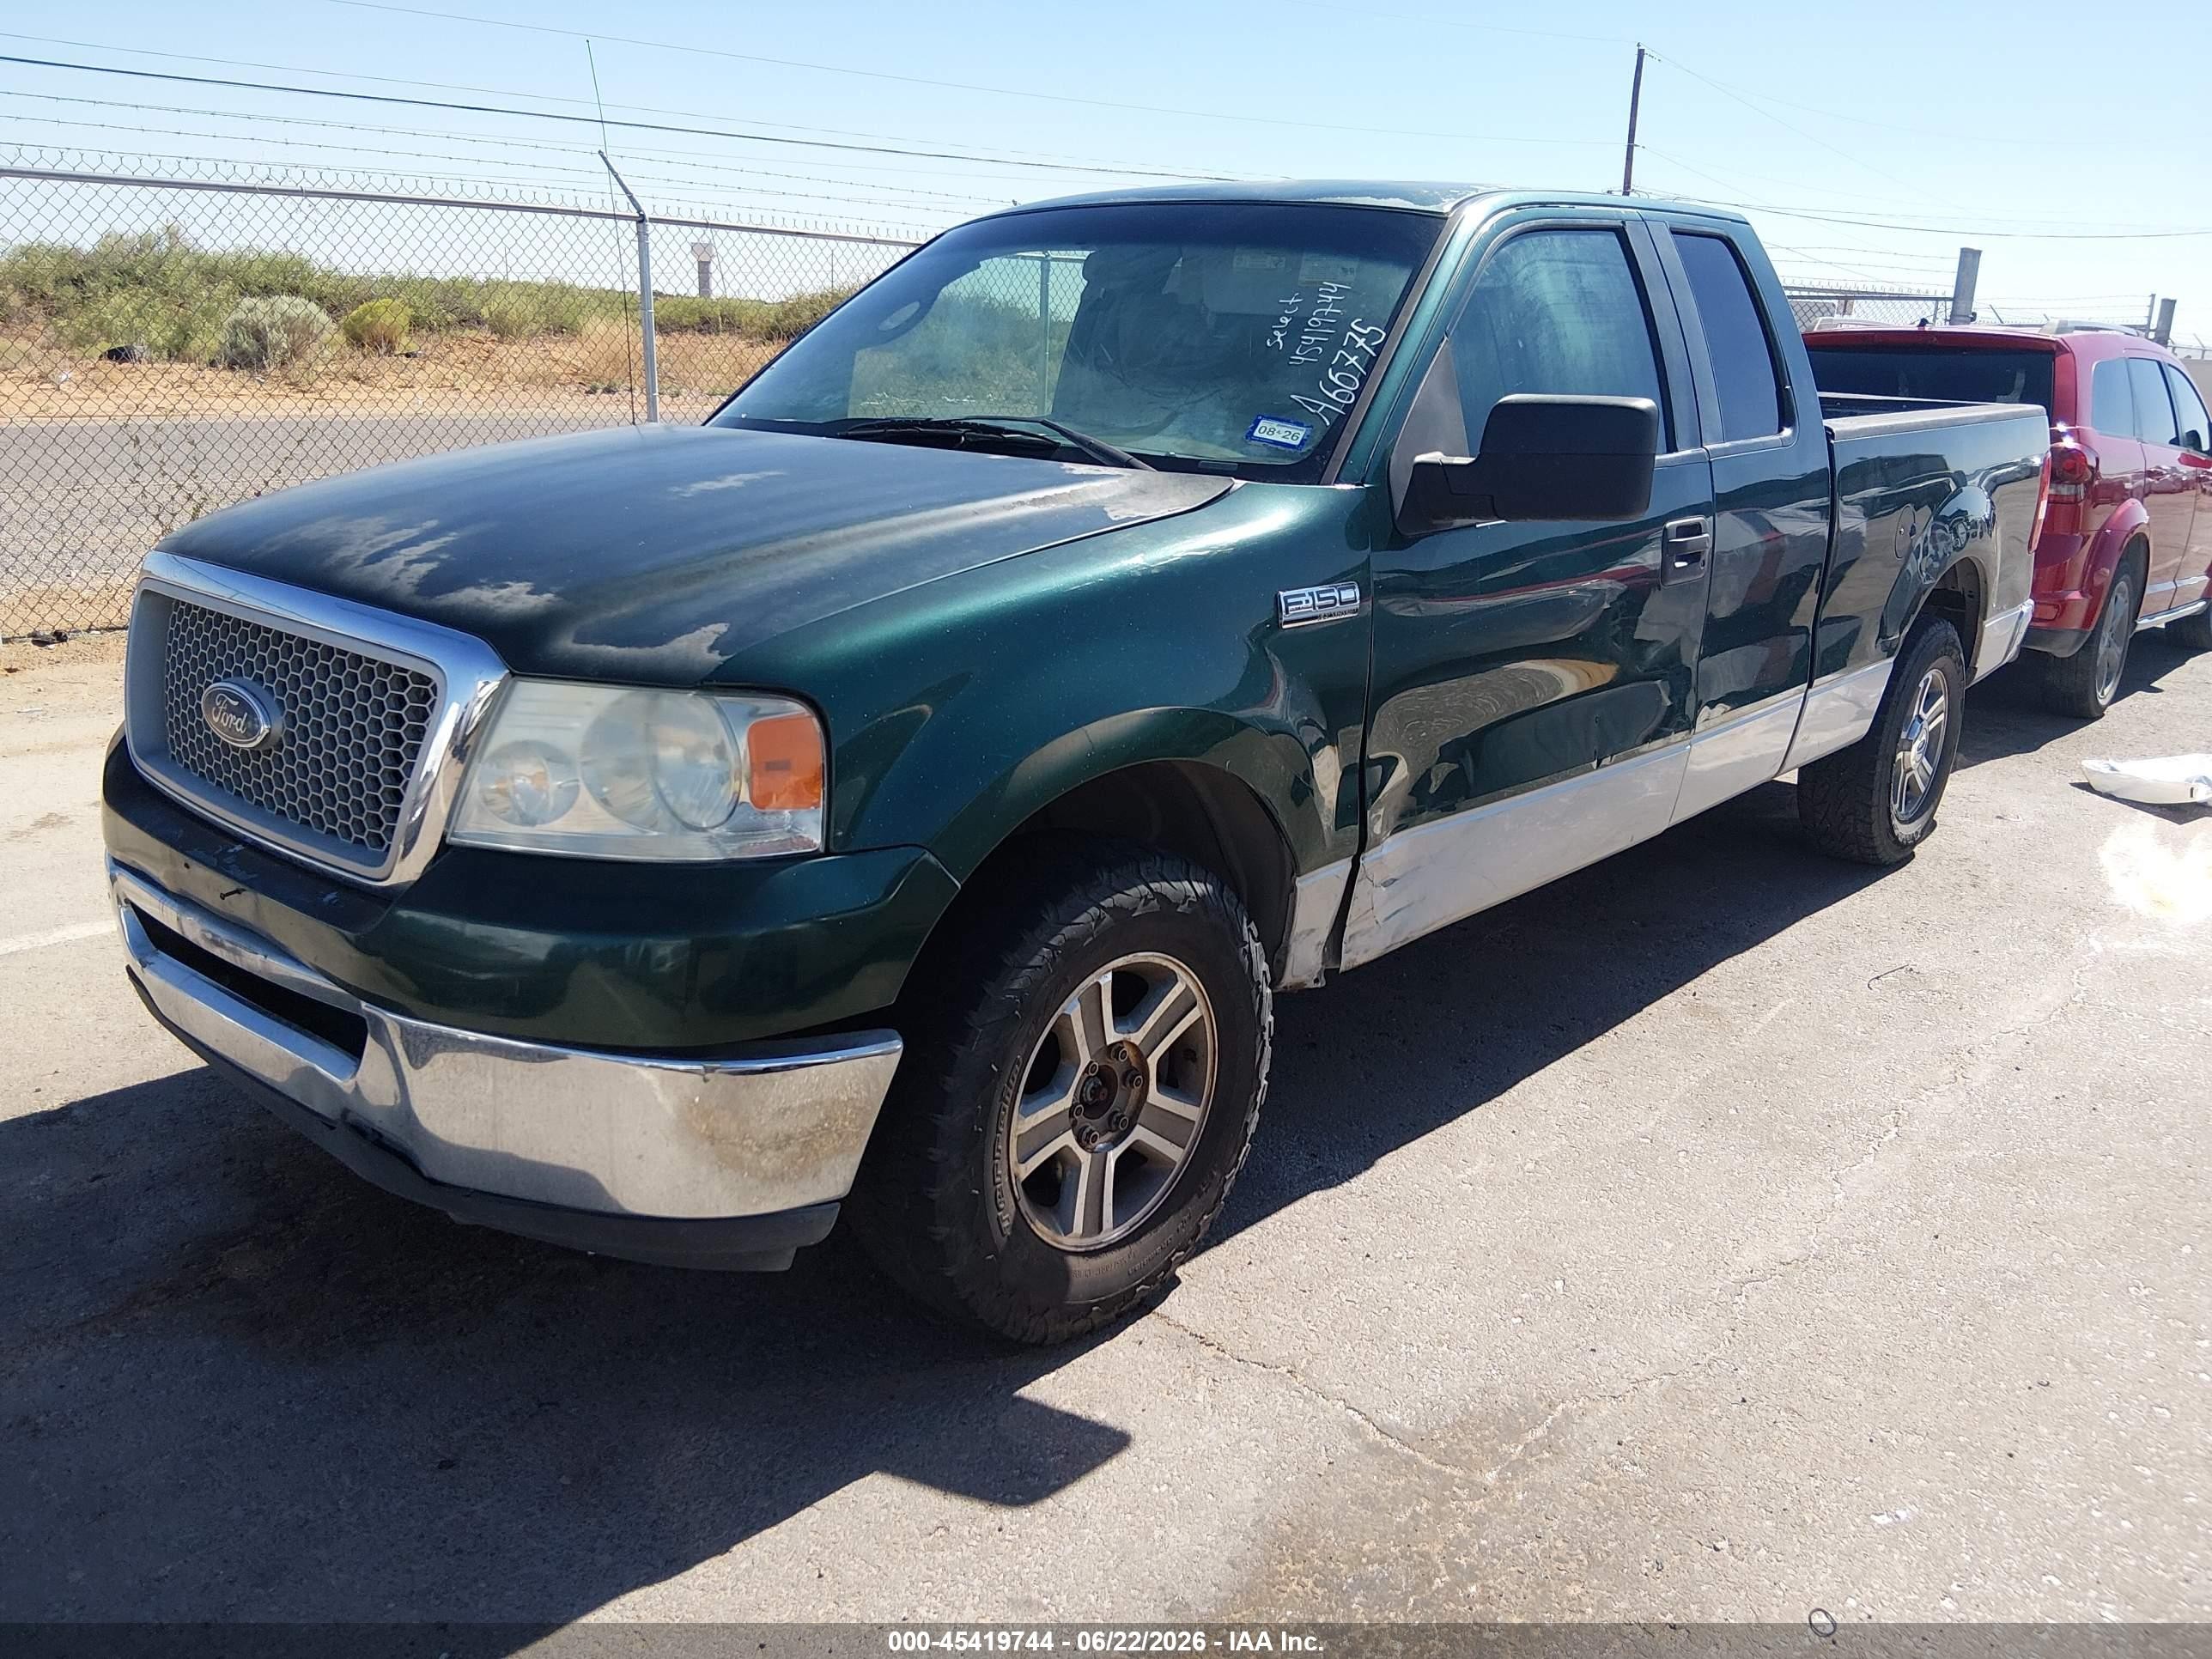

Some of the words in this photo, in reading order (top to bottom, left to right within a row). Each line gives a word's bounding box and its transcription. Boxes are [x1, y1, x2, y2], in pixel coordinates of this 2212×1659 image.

[1289, 282, 1351, 365] 45419744
[1290, 319, 1386, 427] A66775
[212, 693, 248, 734] Ford
